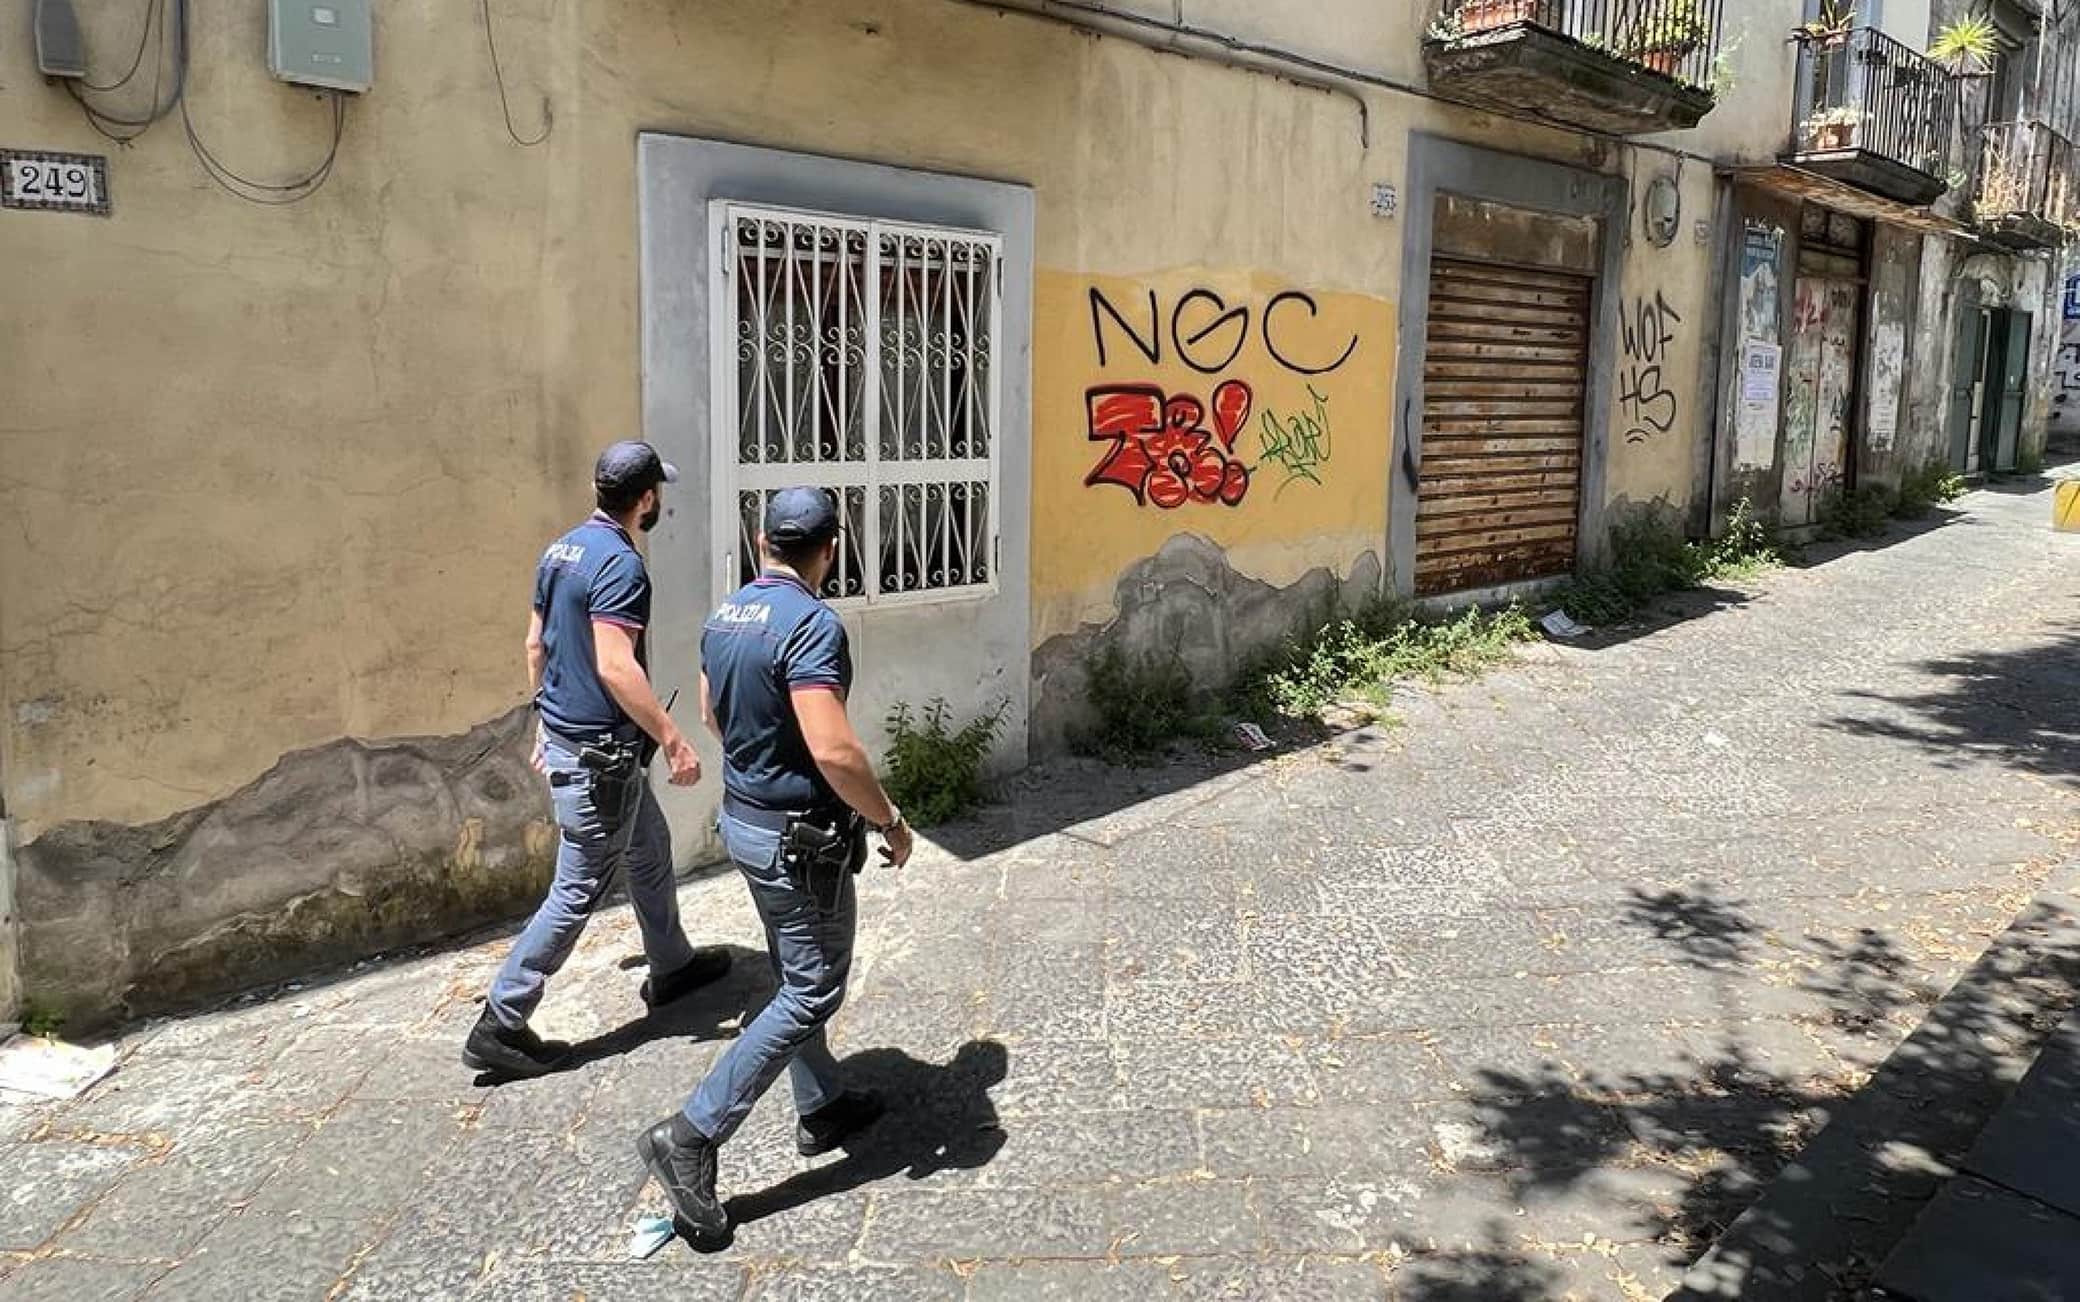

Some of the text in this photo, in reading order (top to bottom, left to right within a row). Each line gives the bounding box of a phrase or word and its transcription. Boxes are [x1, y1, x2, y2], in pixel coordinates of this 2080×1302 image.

[22, 166, 86, 197] 249
[1089, 287, 1358, 374] NGC
[714, 602, 771, 623] POLIZIA
